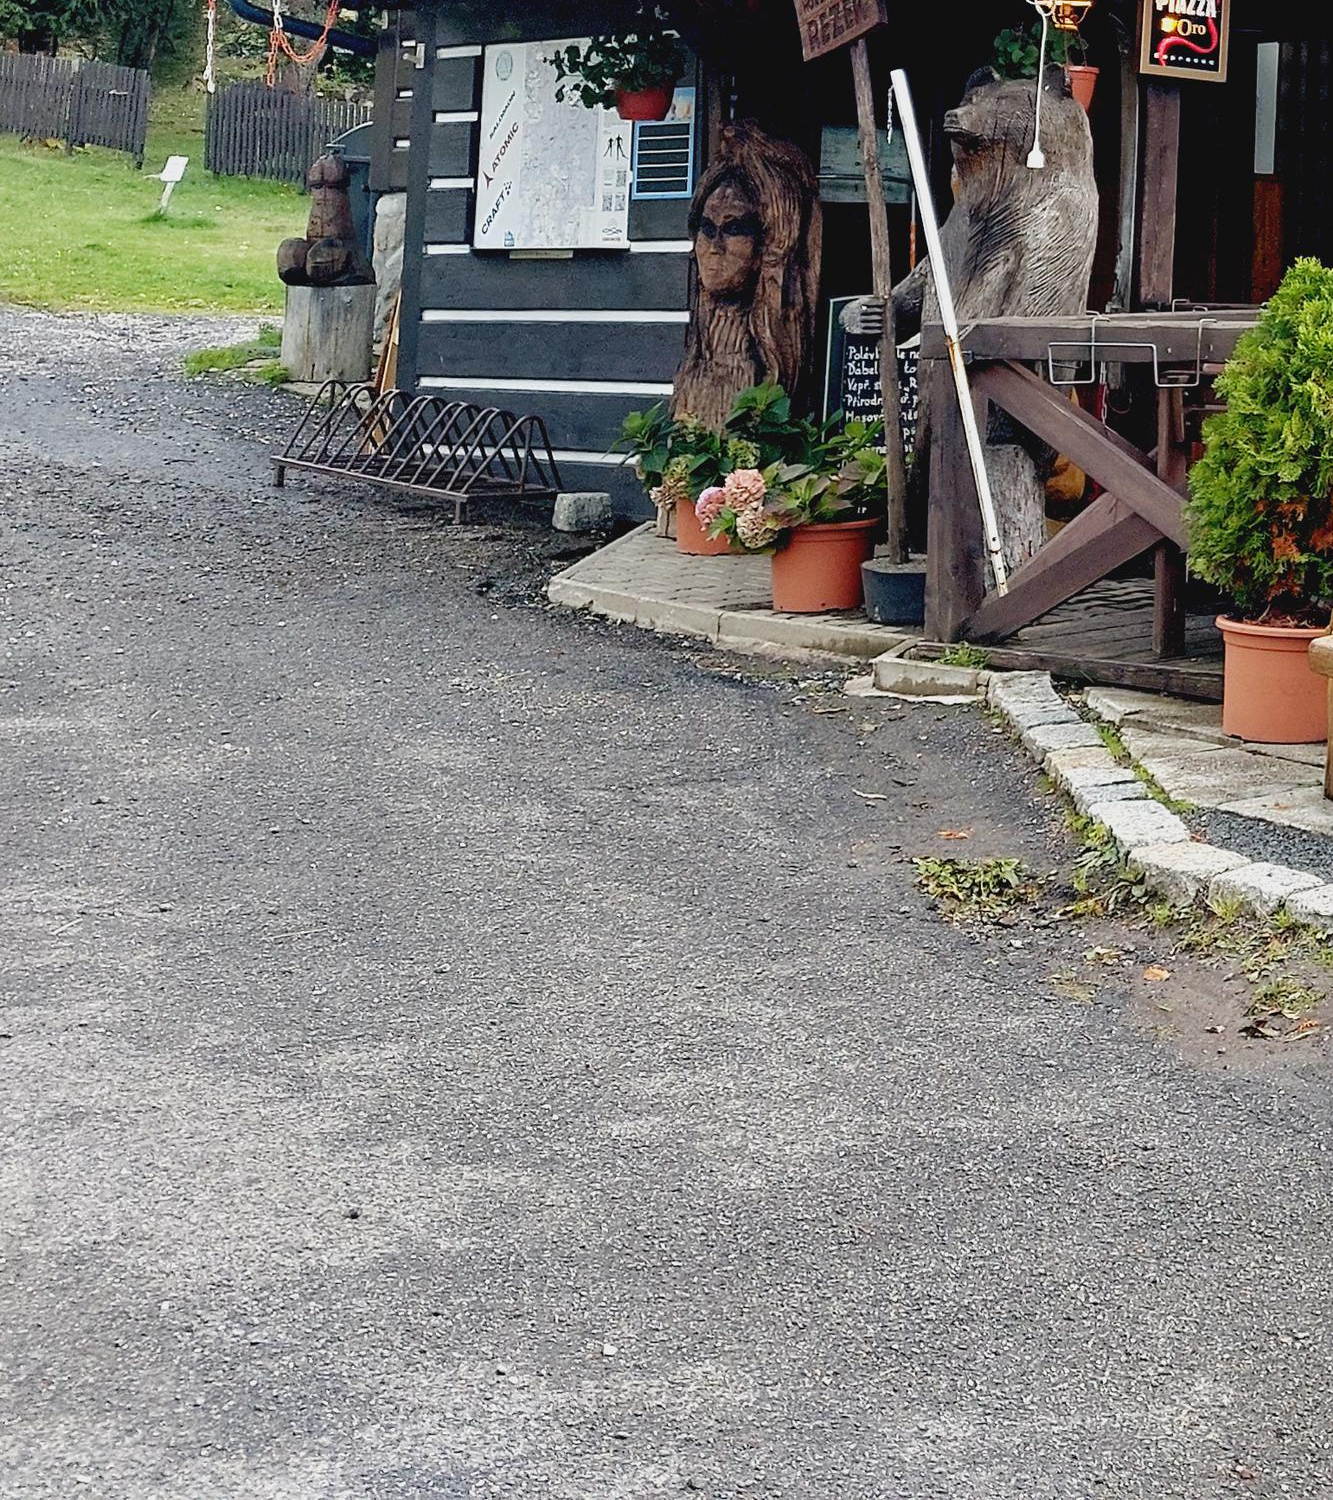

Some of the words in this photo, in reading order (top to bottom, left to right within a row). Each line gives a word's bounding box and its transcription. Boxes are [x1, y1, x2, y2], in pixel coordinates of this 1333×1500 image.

[491, 122, 520, 173] ATOMIC
[481, 192, 508, 236] CRAFT
[847, 361, 879, 376] Ďábel
